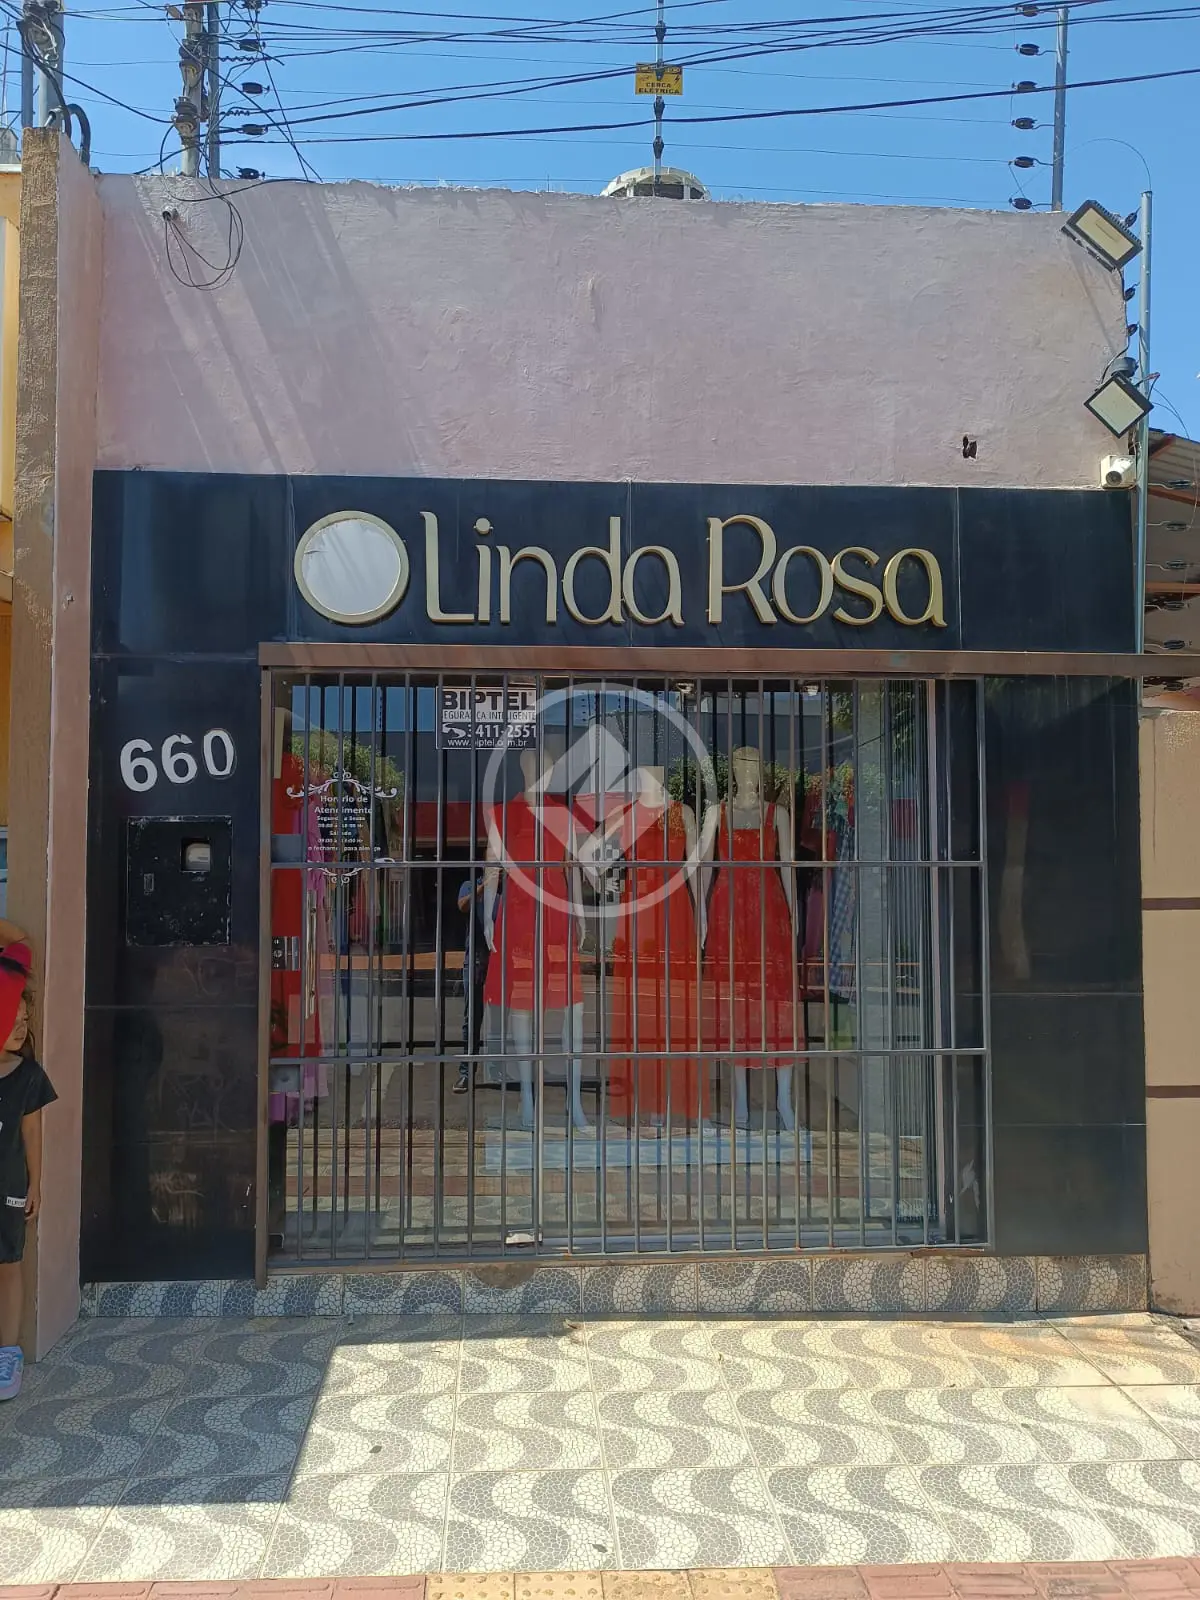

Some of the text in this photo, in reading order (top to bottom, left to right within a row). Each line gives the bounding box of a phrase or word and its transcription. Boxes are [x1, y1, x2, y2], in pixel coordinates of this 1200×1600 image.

[419, 511, 947, 628] Linda Rosa
[441, 691, 535, 710] BIPTEL
[120, 728, 235, 792] 660
[356, 795, 369, 803] de
